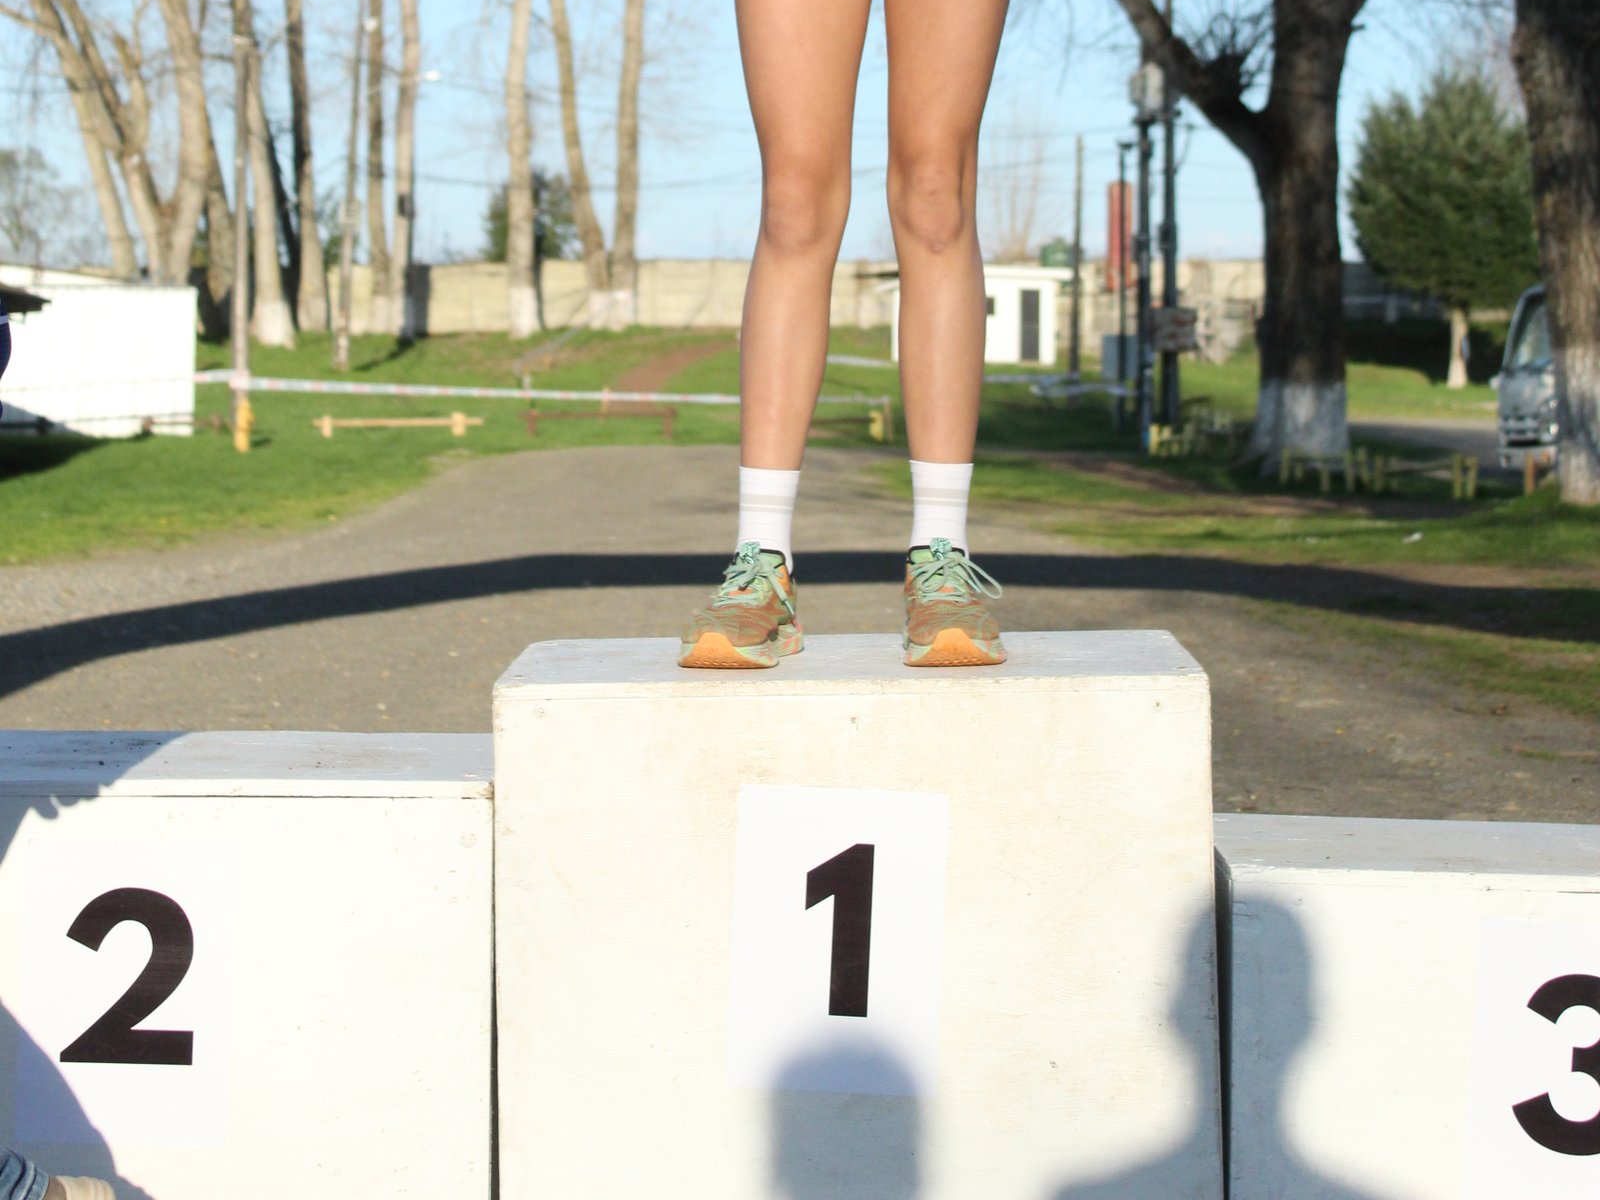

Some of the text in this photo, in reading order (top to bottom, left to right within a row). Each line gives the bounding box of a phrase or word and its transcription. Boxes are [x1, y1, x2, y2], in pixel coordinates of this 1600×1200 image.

[60, 888, 194, 1065] 2
[806, 844, 875, 1017] 1
[1512, 974, 1600, 1156] 3
